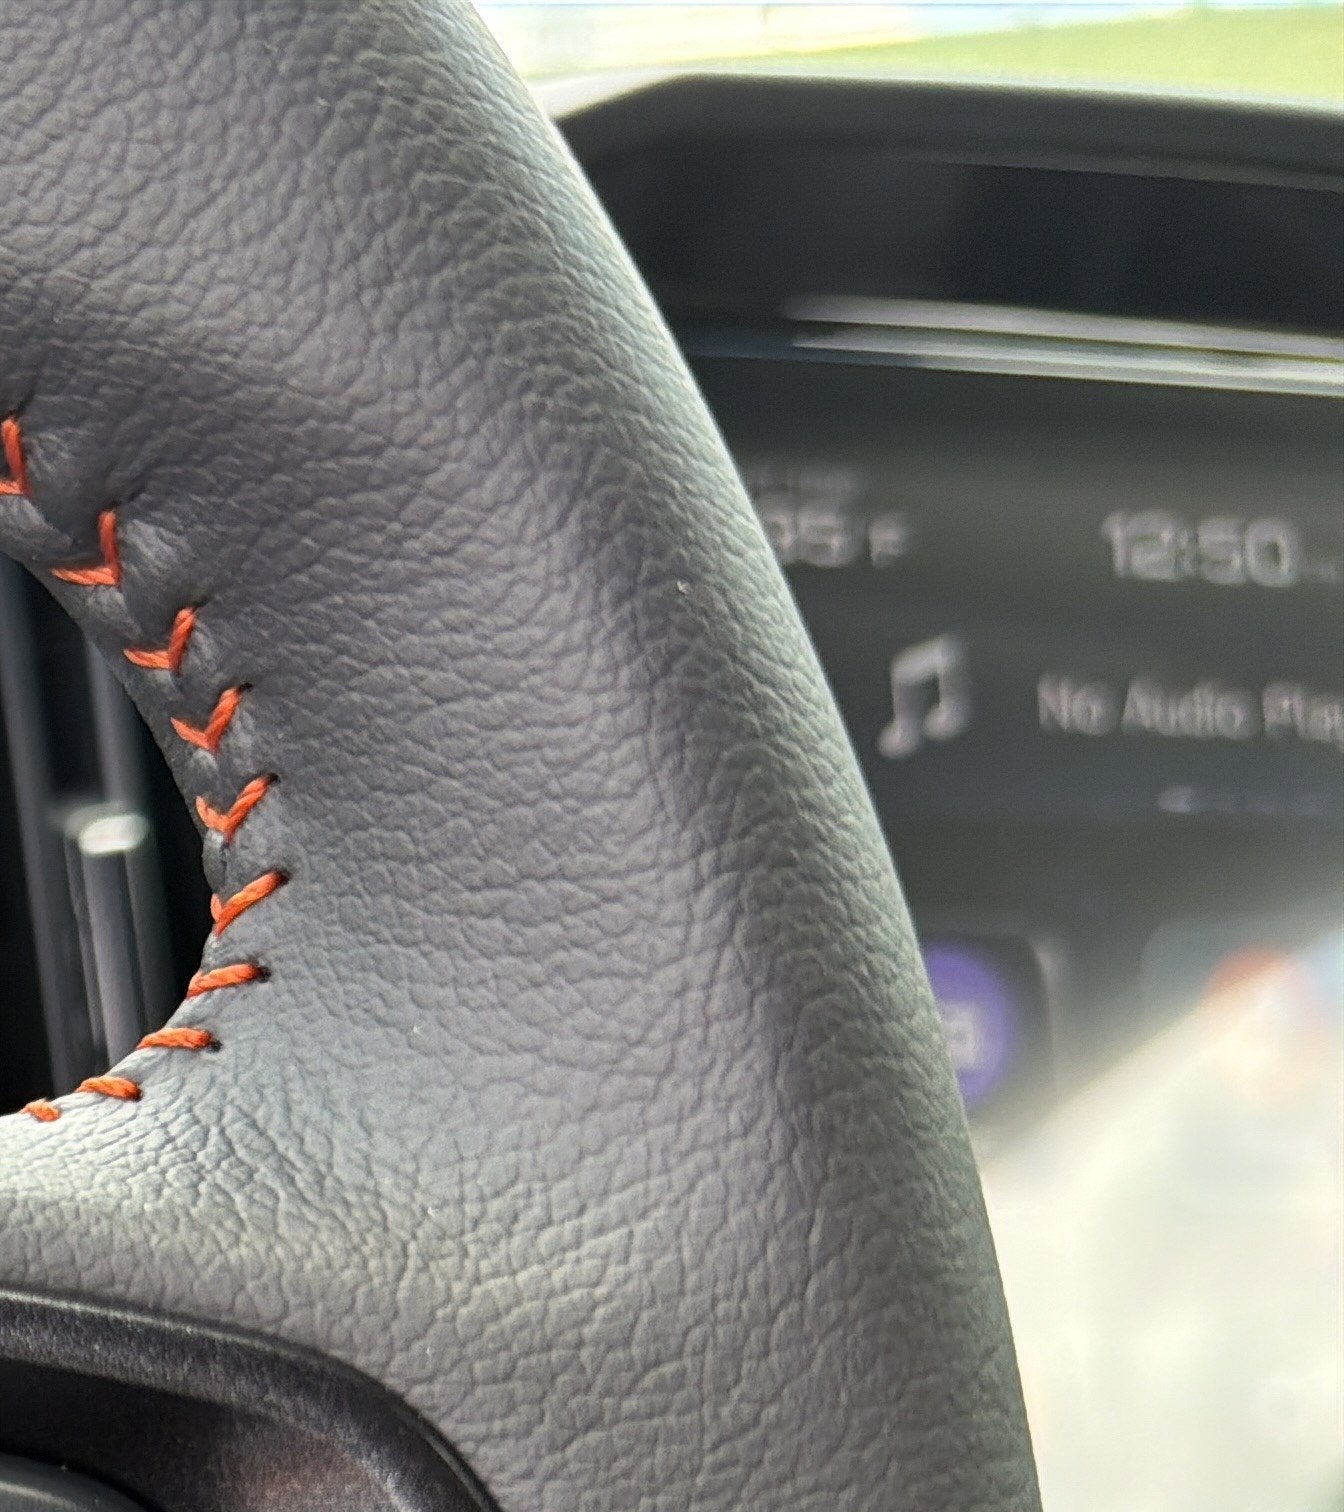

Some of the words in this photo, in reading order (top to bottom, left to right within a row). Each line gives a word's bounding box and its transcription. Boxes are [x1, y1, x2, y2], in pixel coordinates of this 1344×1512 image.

[1101, 509, 1299, 586] 12:50
[1036, 673, 1112, 736] No
[1120, 675, 1255, 741] Audio
